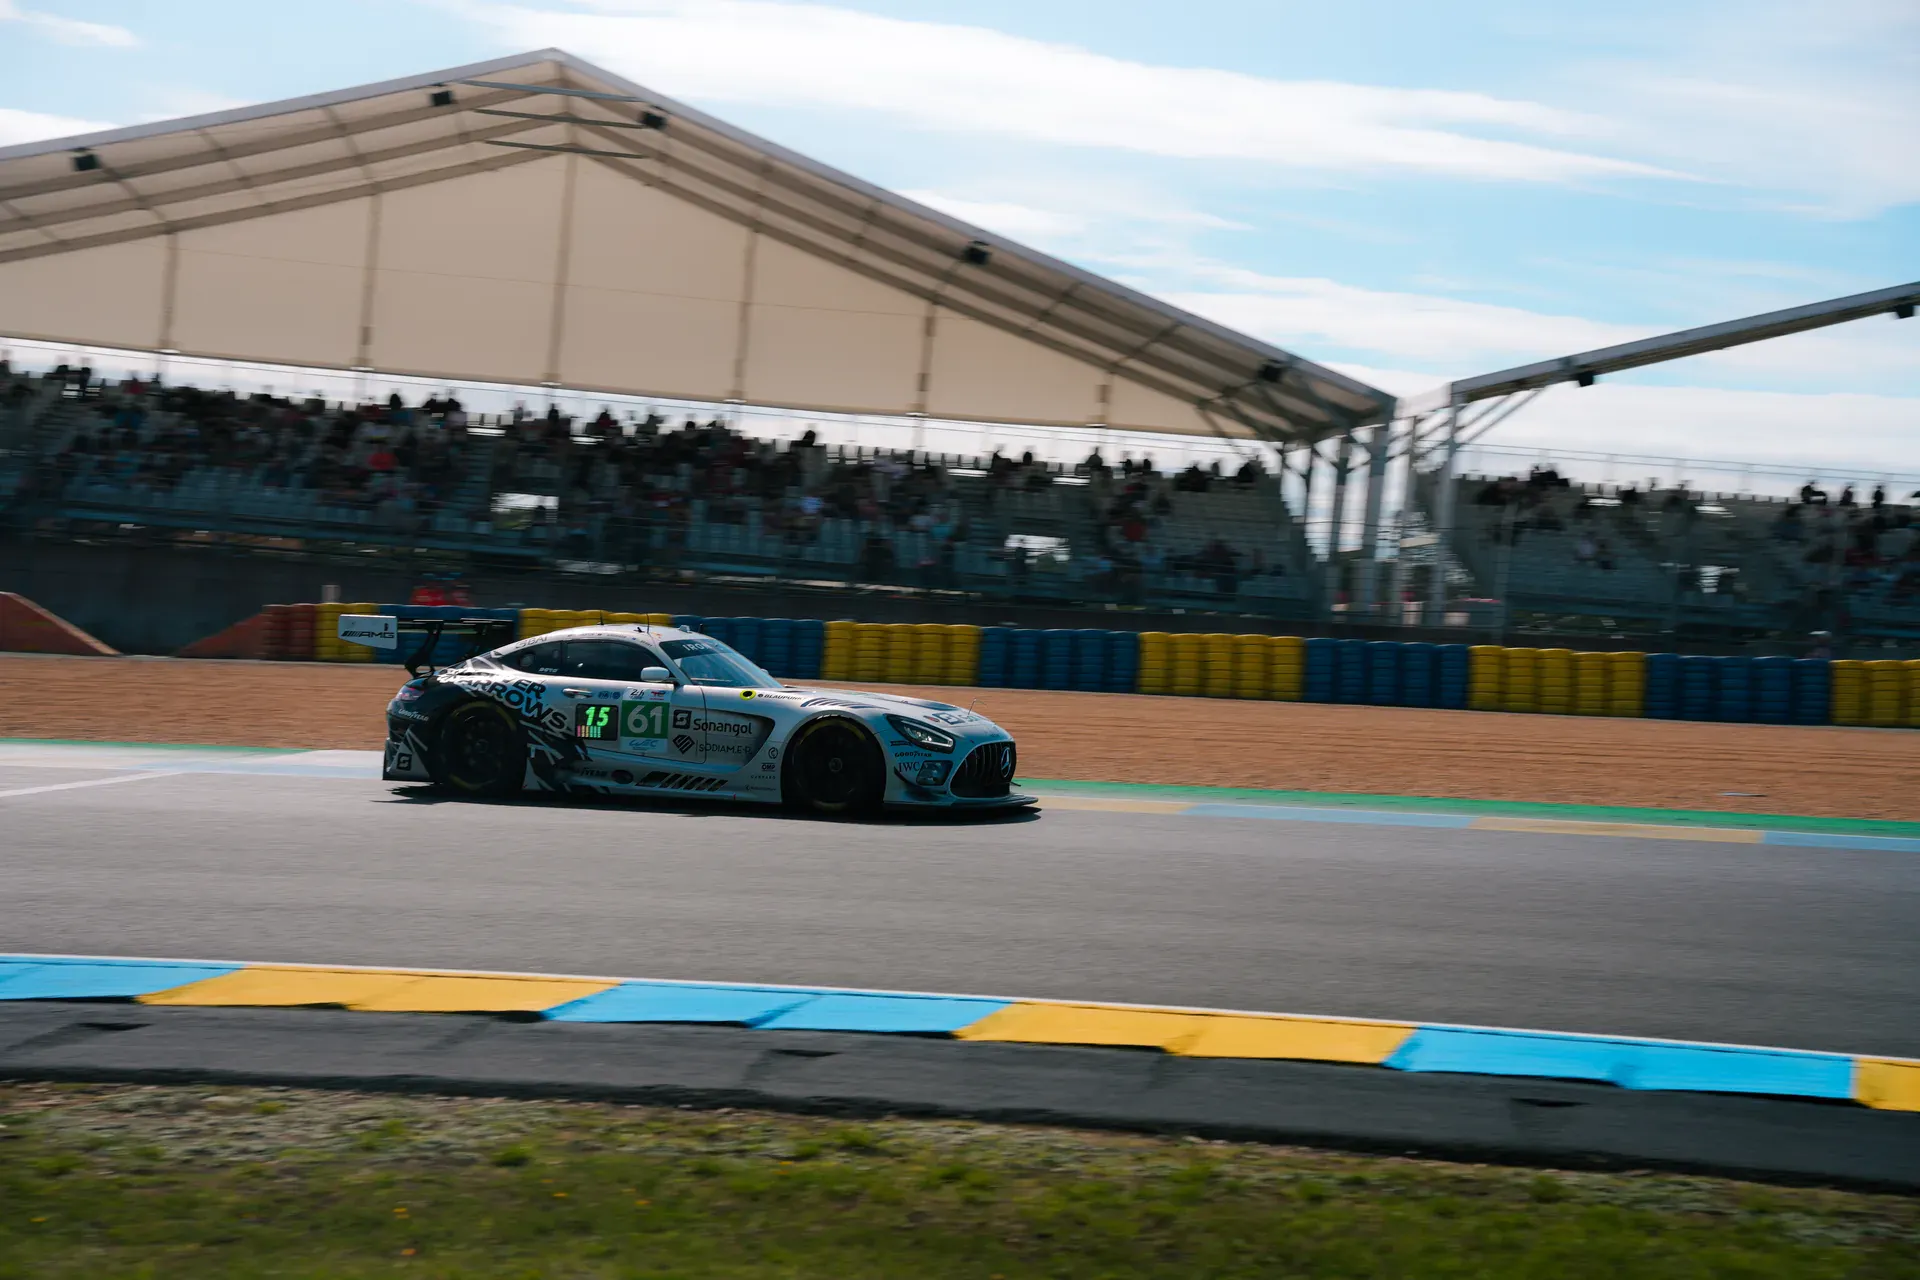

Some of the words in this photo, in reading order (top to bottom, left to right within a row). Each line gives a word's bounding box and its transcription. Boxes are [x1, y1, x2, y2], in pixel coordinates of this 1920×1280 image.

[585, 706, 611, 727] 15
[627, 704, 663, 735] 61
[693, 718, 752, 737] Sonangol
[897, 761, 920, 773] IWC
